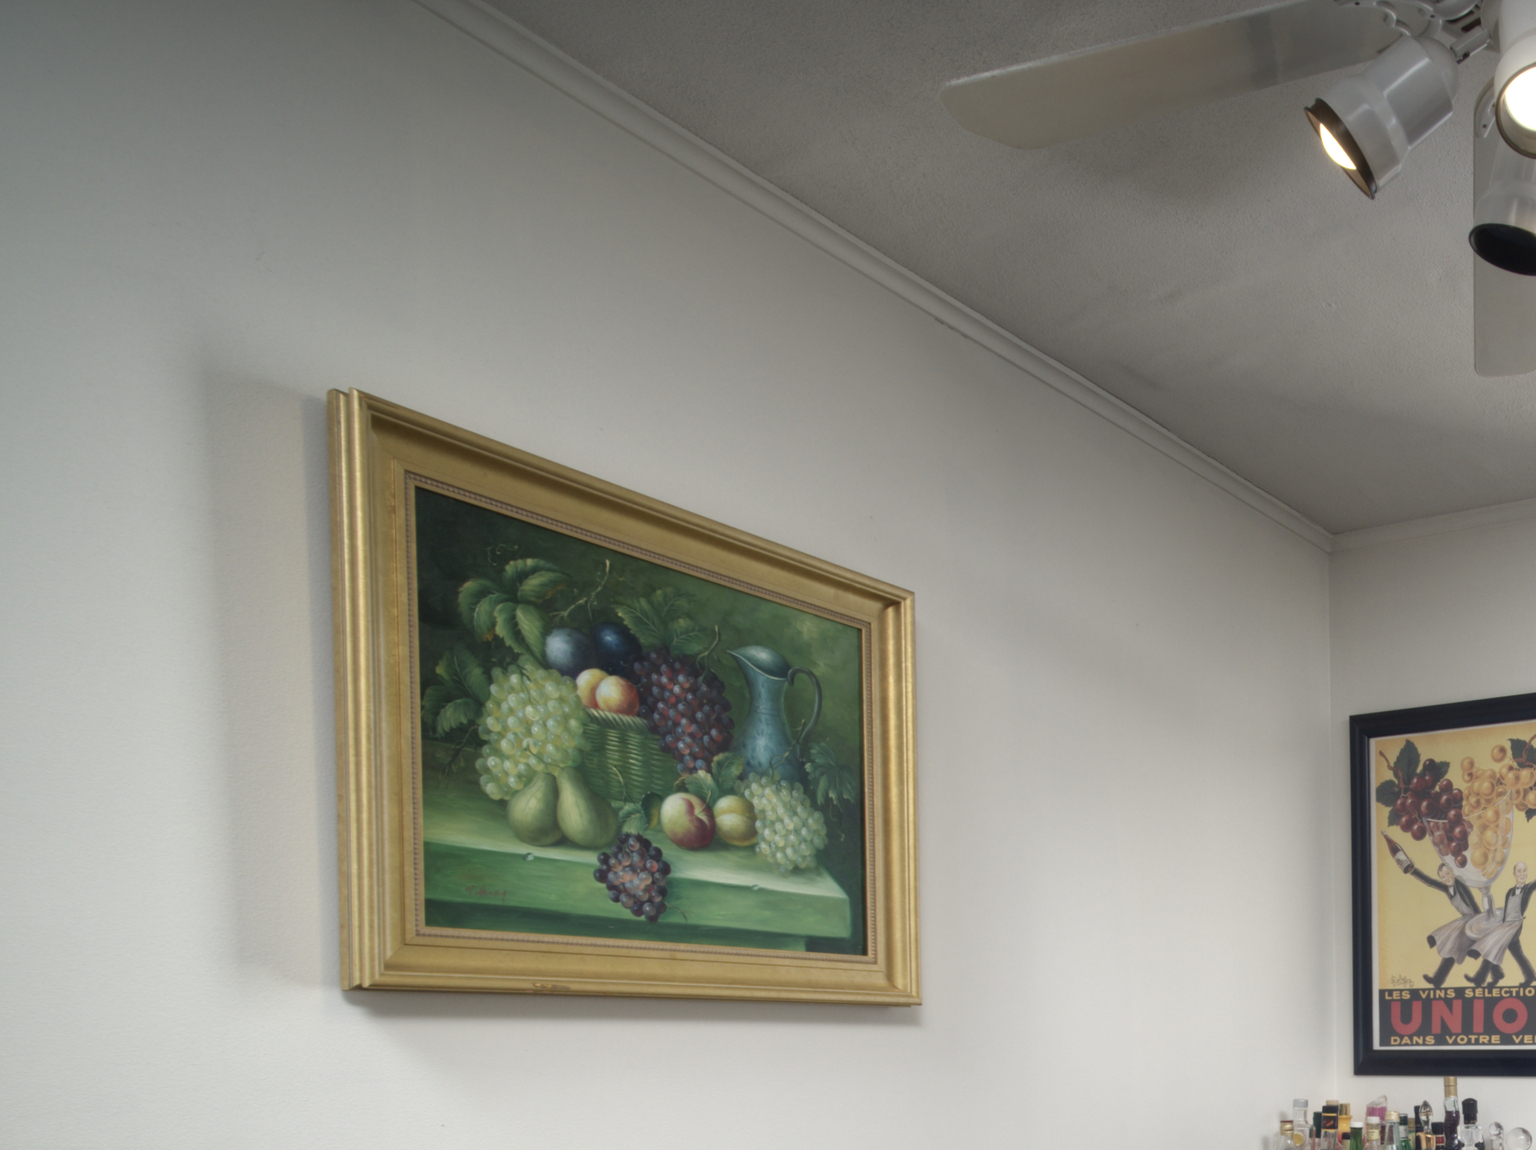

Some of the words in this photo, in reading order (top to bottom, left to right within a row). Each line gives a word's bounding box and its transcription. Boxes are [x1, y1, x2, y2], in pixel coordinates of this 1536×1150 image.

[1385, 991, 1411, 1000] LES
[1419, 989, 1456, 999] VINS
[1390, 1035, 1435, 1045] DANS
[1445, 1035, 1501, 1044] VOTRE
